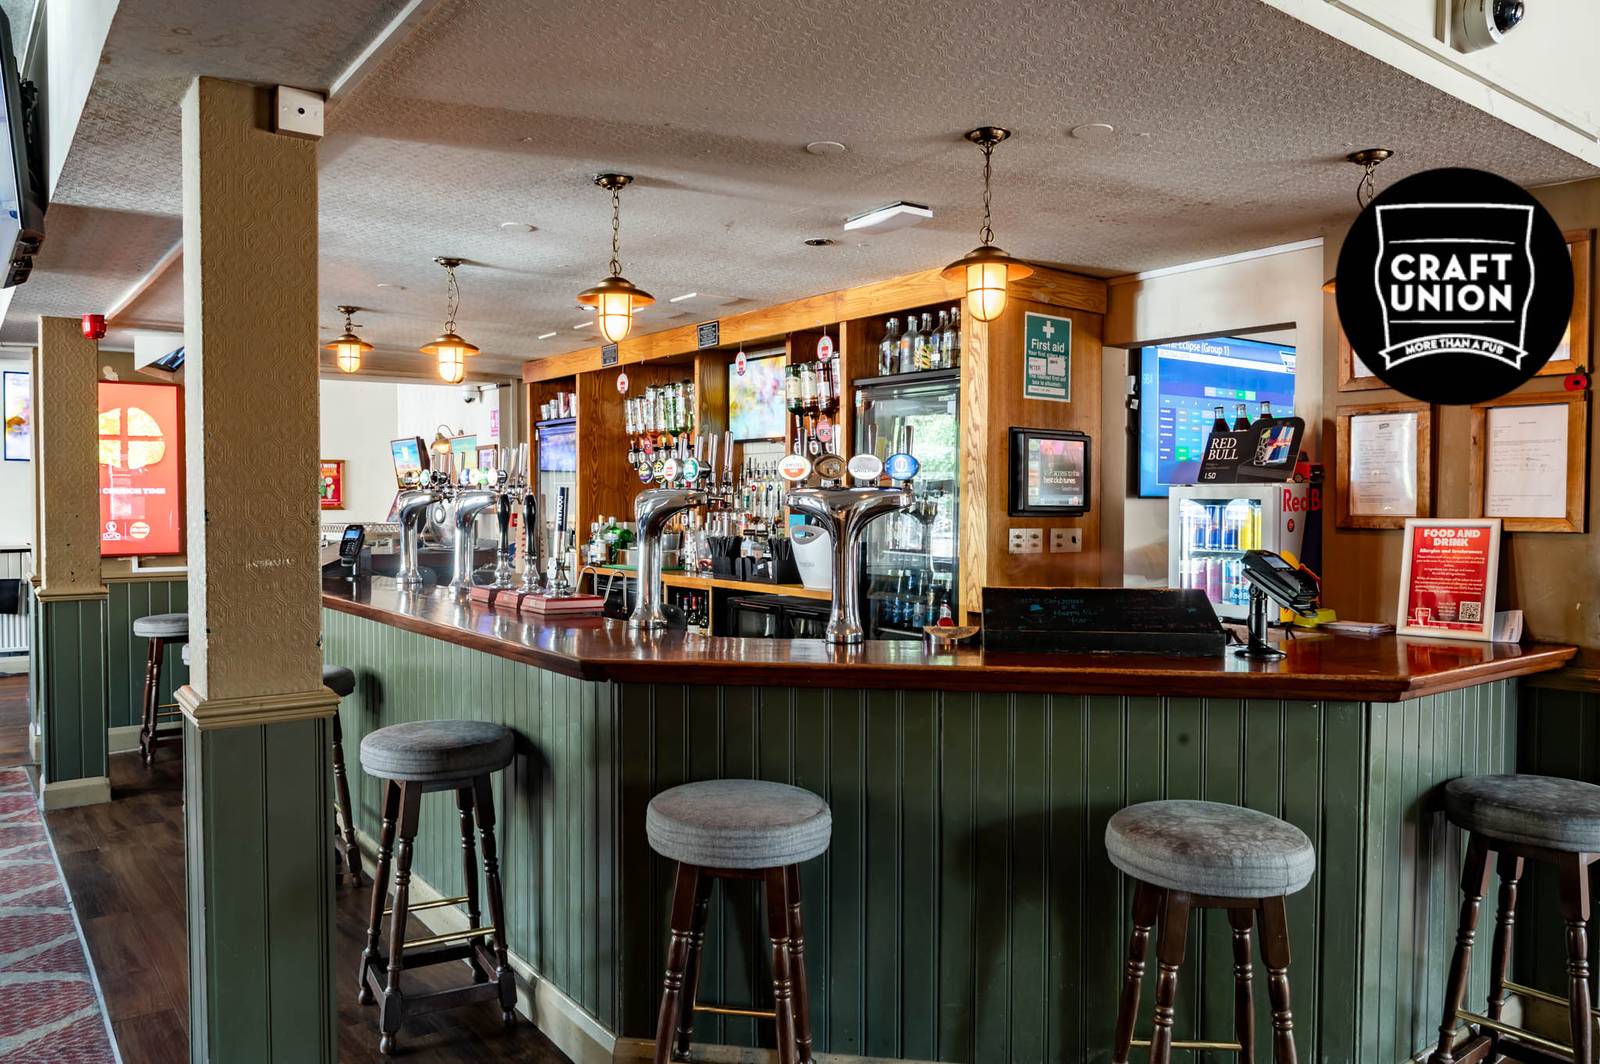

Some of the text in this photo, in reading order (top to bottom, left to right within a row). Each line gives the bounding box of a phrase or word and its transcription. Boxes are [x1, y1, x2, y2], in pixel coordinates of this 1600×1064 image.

[1031, 338, 1065, 353] First aid
[1211, 437, 1237, 449] RED
[1208, 448, 1239, 460] BULL
[142, 487, 166, 495] TIME
[1283, 487, 1309, 512] Red
[1424, 529, 1480, 538] FOOD AND
[1433, 538, 1468, 547] DRINK
